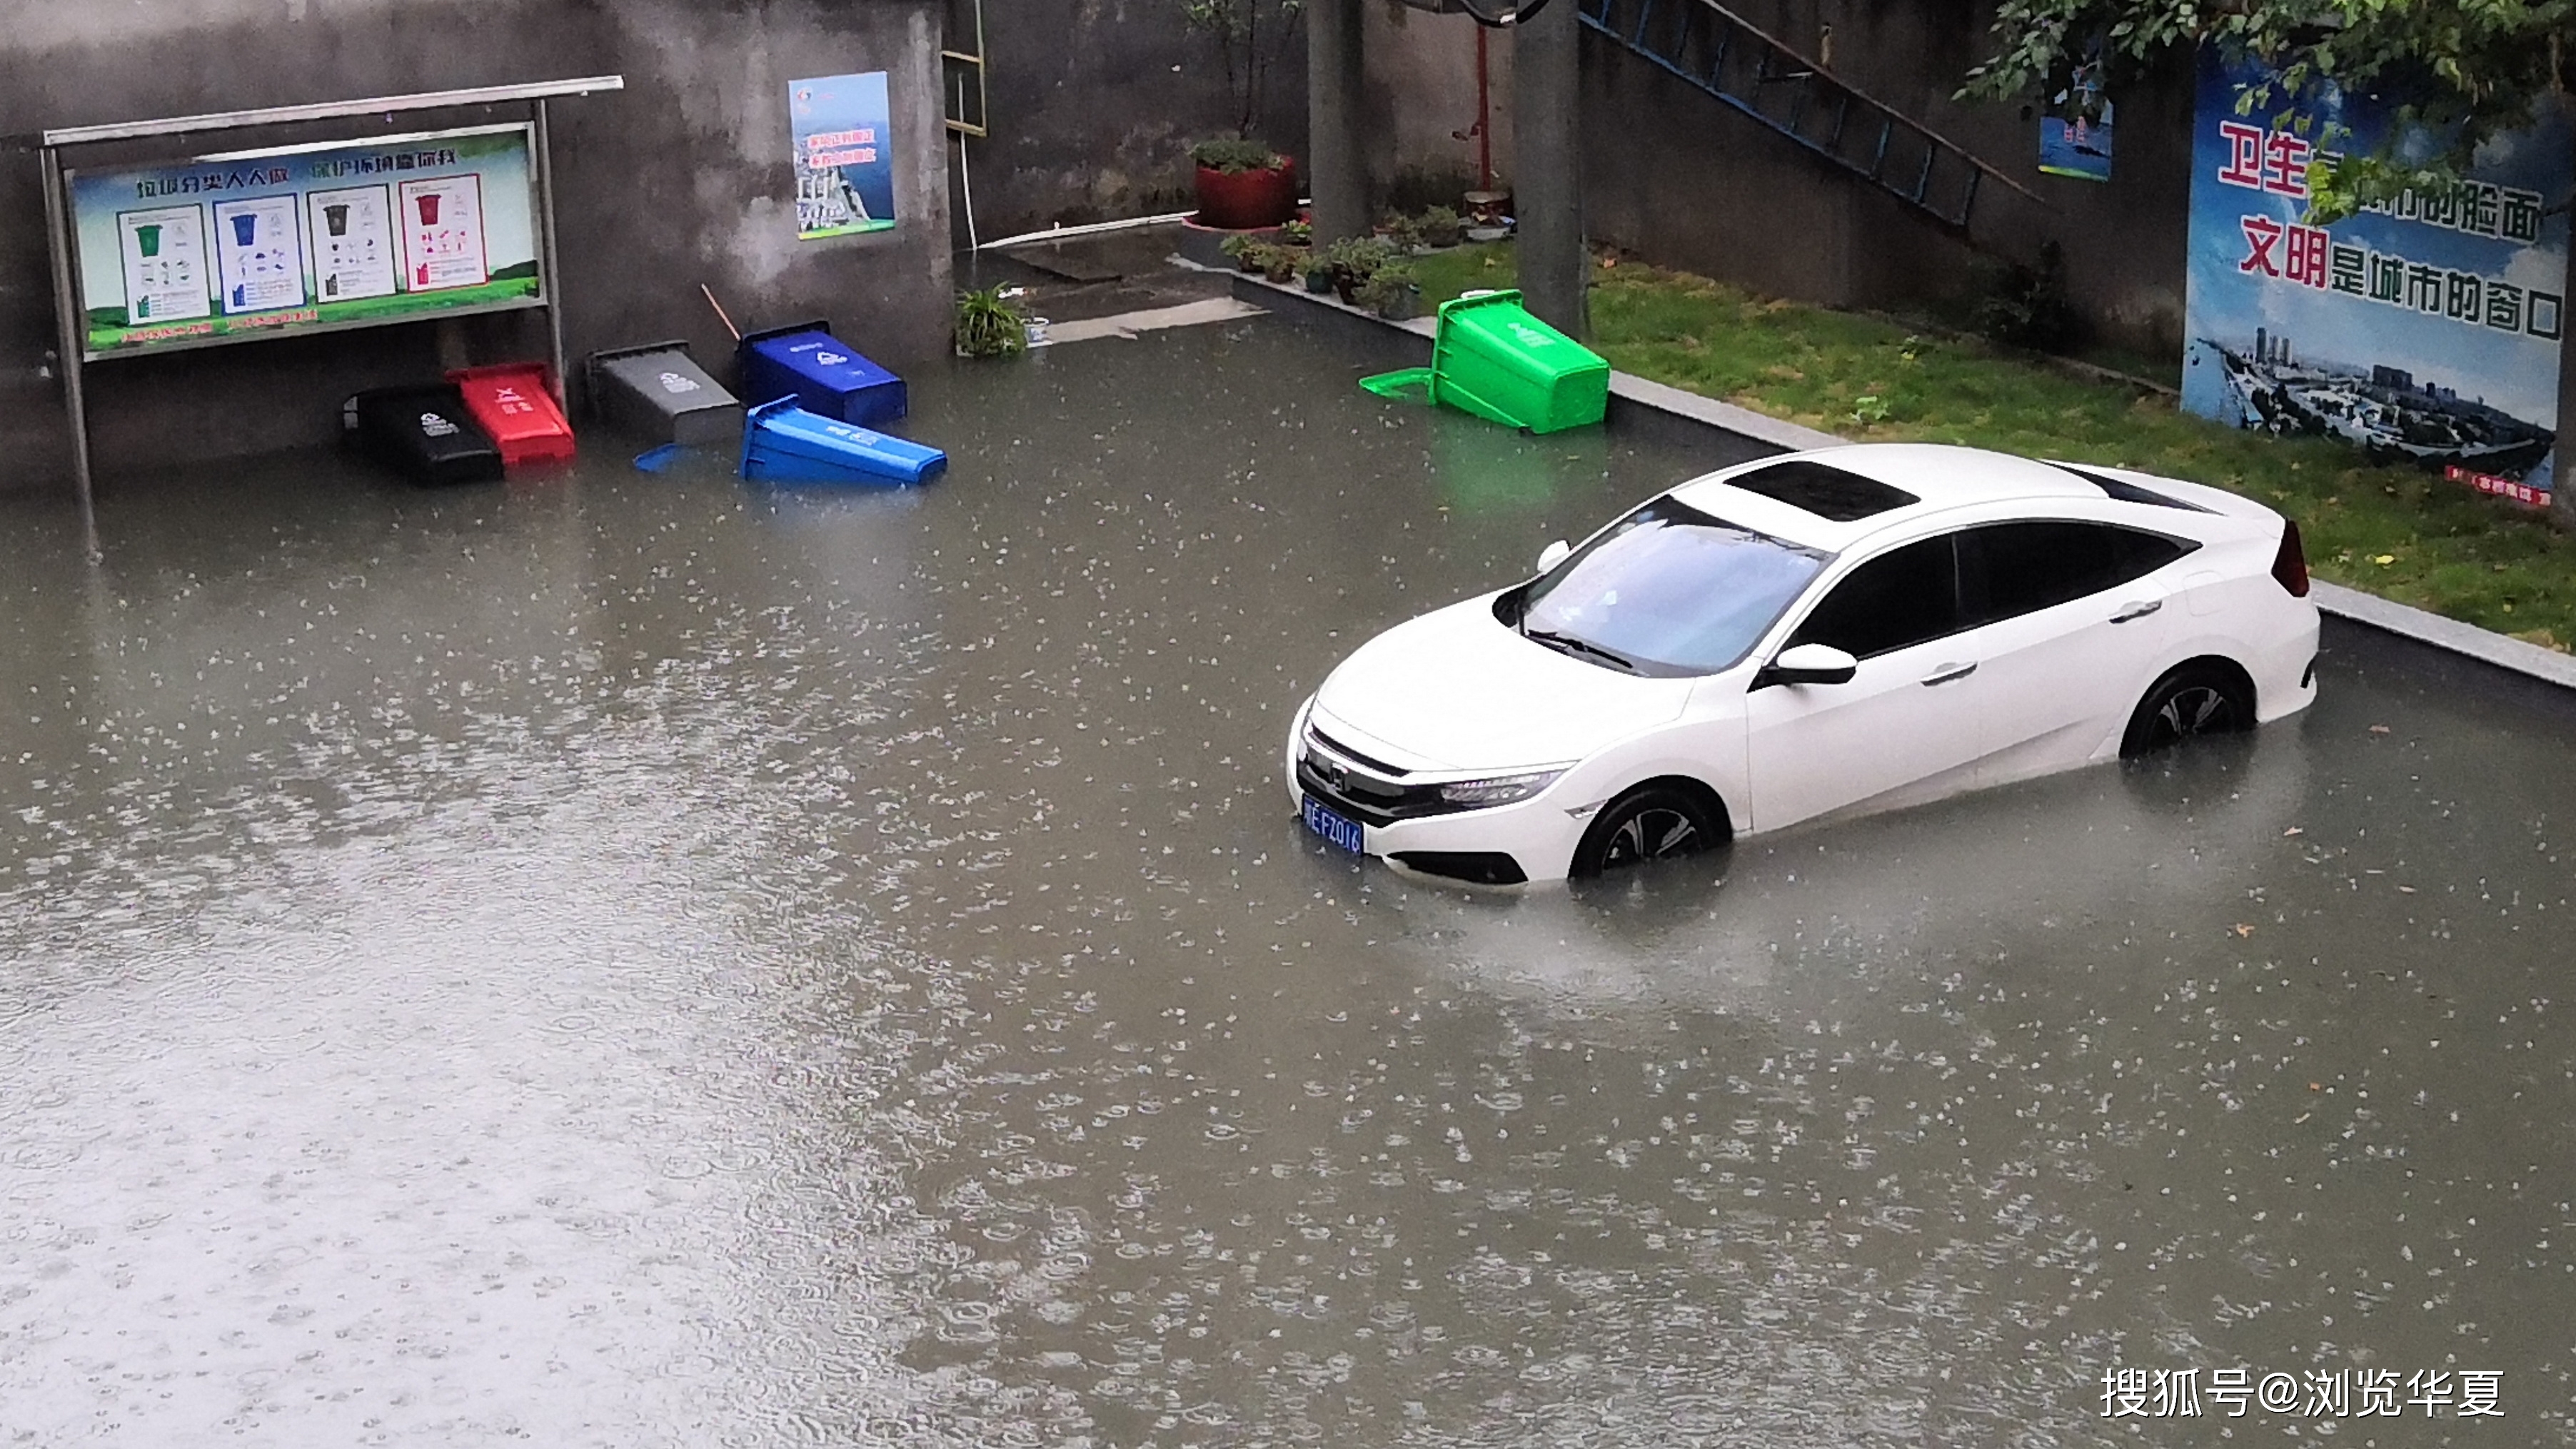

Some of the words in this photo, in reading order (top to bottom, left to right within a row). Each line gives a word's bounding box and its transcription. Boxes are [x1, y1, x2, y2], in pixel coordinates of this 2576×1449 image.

[136, 168, 290, 199] 垃圾分类人人做
[2218, 121, 2542, 245] 卫生市的脸面
[2239, 214, 2563, 340] 文明是城市的窗口
